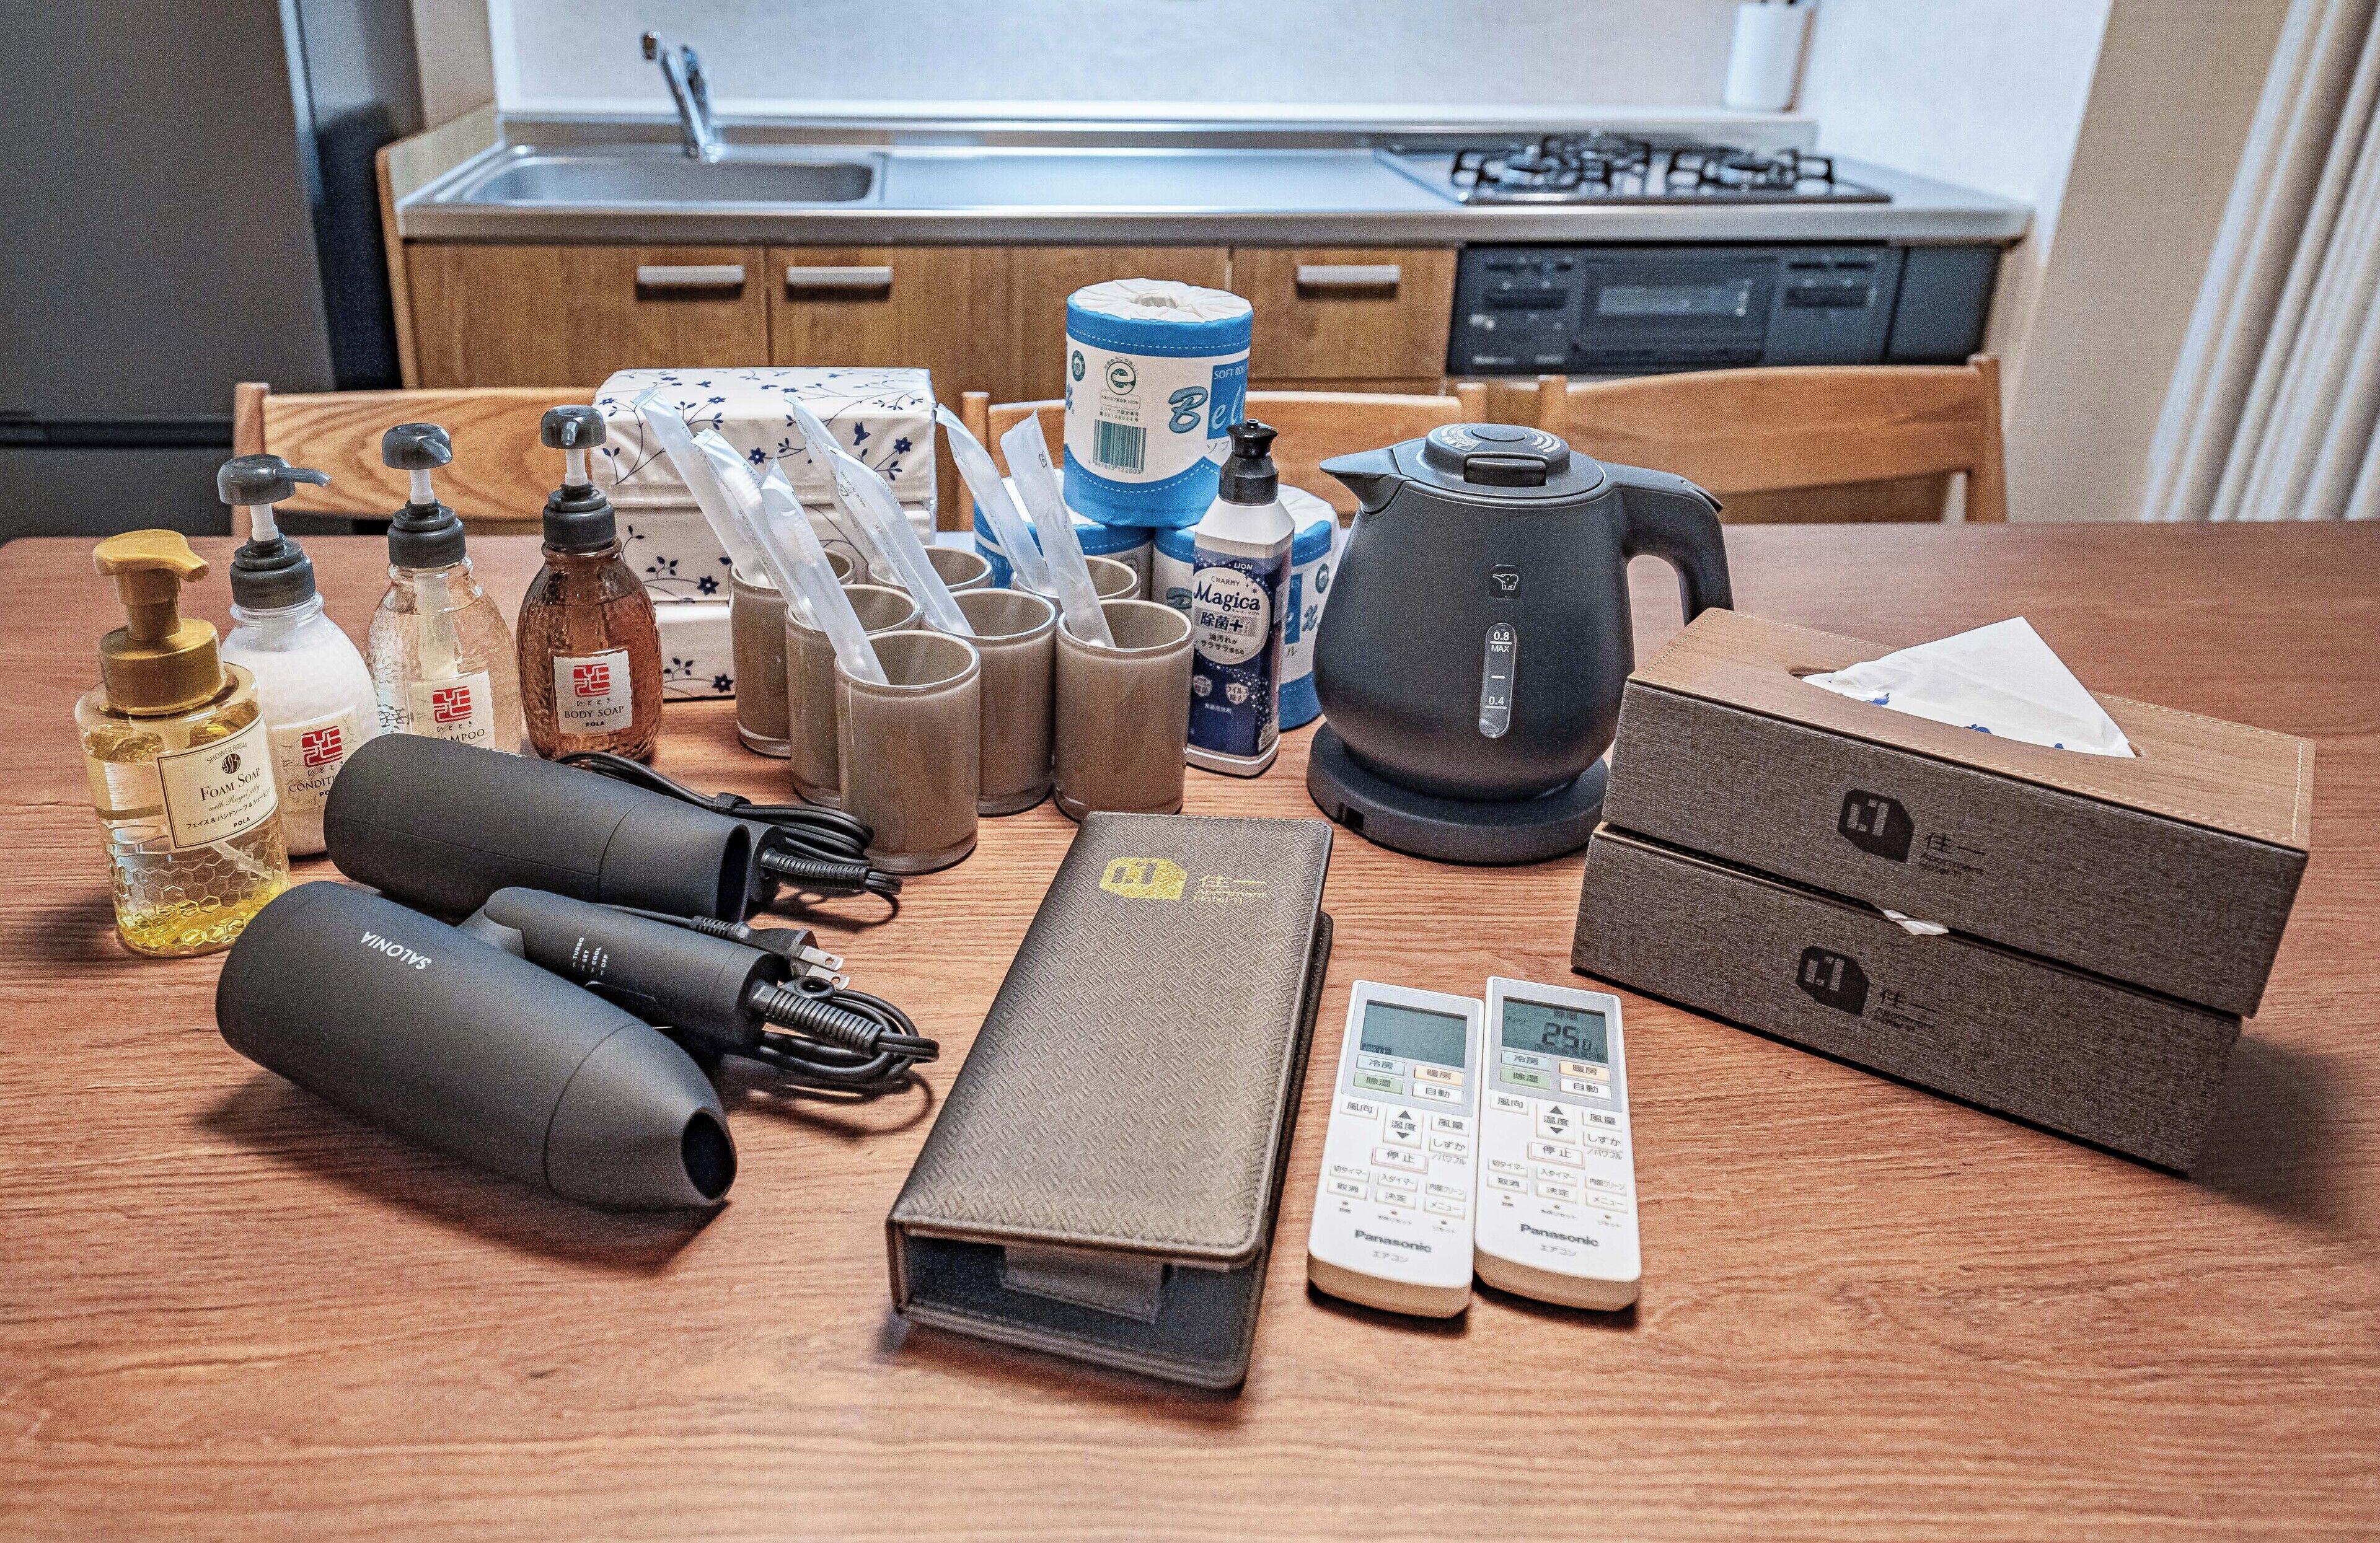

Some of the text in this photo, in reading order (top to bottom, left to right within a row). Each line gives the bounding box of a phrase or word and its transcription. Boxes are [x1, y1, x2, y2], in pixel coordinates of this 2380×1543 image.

[1214, 369, 1234, 379] SOFT
[1233, 561, 1253, 570] LION
[1210, 576, 1240, 586] CHARMY
[1193, 580, 1261, 612] Magica
[1493, 631, 1510, 641] 0.8
[1491, 644, 1510, 653] MAX
[1488, 696, 1504, 705] 0.4
[565, 705, 624, 718] BODY SOAP
[206, 742, 249, 764] SHOWER BREAK
[209, 801, 224, 812] with
[226, 794, 249, 806] Royal
[234, 817, 250, 828] POLA
[360, 931, 432, 970] SALONIA
[572, 937, 584, 959] TURBO
[591, 946, 602, 965] COOL
[1369, 1058, 1393, 1070] 冷房
[1514, 1055, 1538, 1065] 冷房
[1427, 1069, 1452, 1080] 暖房
[1572, 1064, 1597, 1075] 暖房
[1367, 1076, 1391, 1088] 除湿
[1513, 1072, 1538, 1083] 除湿
[1426, 1087, 1450, 1099] 自動
[1574, 1083, 1598, 1093] 自動
[1347, 1102, 1372, 1114] 風向
[1497, 1097, 1523, 1108] 風向
[1438, 1119, 1463, 1130] 風量
[1543, 1115, 1569, 1127] 温度
[1590, 1114, 1616, 1125] 風量
[1391, 1120, 1416, 1132] 温度
[1497, 1177, 1520, 1187] 取消
[1337, 1183, 1359, 1193] 取消
[1546, 1186, 1569, 1197] 決定
[1384, 1192, 1407, 1203] 決定
[1593, 1197, 1624, 1206] メニュー
[1430, 1201, 1461, 1211] メニュー
[1355, 1229, 1432, 1253] Panasonic
[1520, 1224, 1599, 1247] Panasonic
[1372, 1249, 1409, 1263] エアコン
[1540, 1244, 1576, 1257] エアコン
